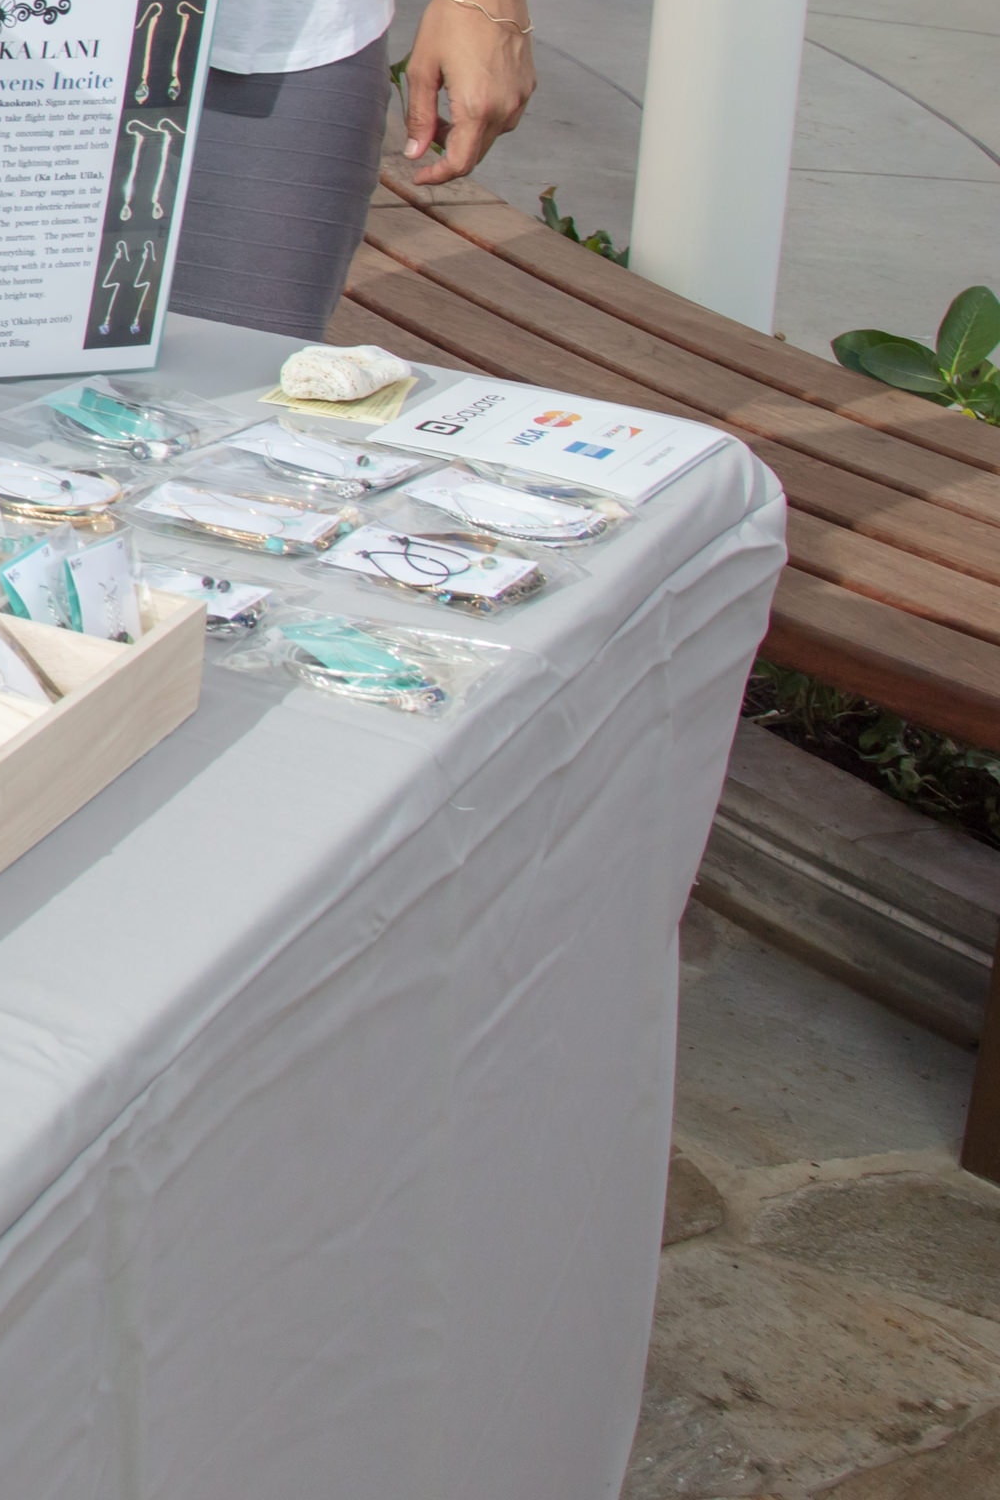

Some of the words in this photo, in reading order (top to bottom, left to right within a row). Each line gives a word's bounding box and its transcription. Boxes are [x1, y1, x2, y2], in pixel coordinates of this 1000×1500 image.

[41, 39, 101, 59] LANI
[53, 71, 113, 90] Incite
[5, 114, 21, 122] take
[48, 113, 64, 121] into
[2, 160, 16, 168] The
[34, 173, 50, 182] (Ka
[15, 220, 40, 229] power
[84, 216, 98, 224] The
[45, 232, 59, 240] The
[88, 230, 95, 238] to
[50, 314, 72, 324] 2016)
[9, 339, 30, 348] Bling
[442, 394, 506, 423] Square
[507, 428, 550, 446] VISA
